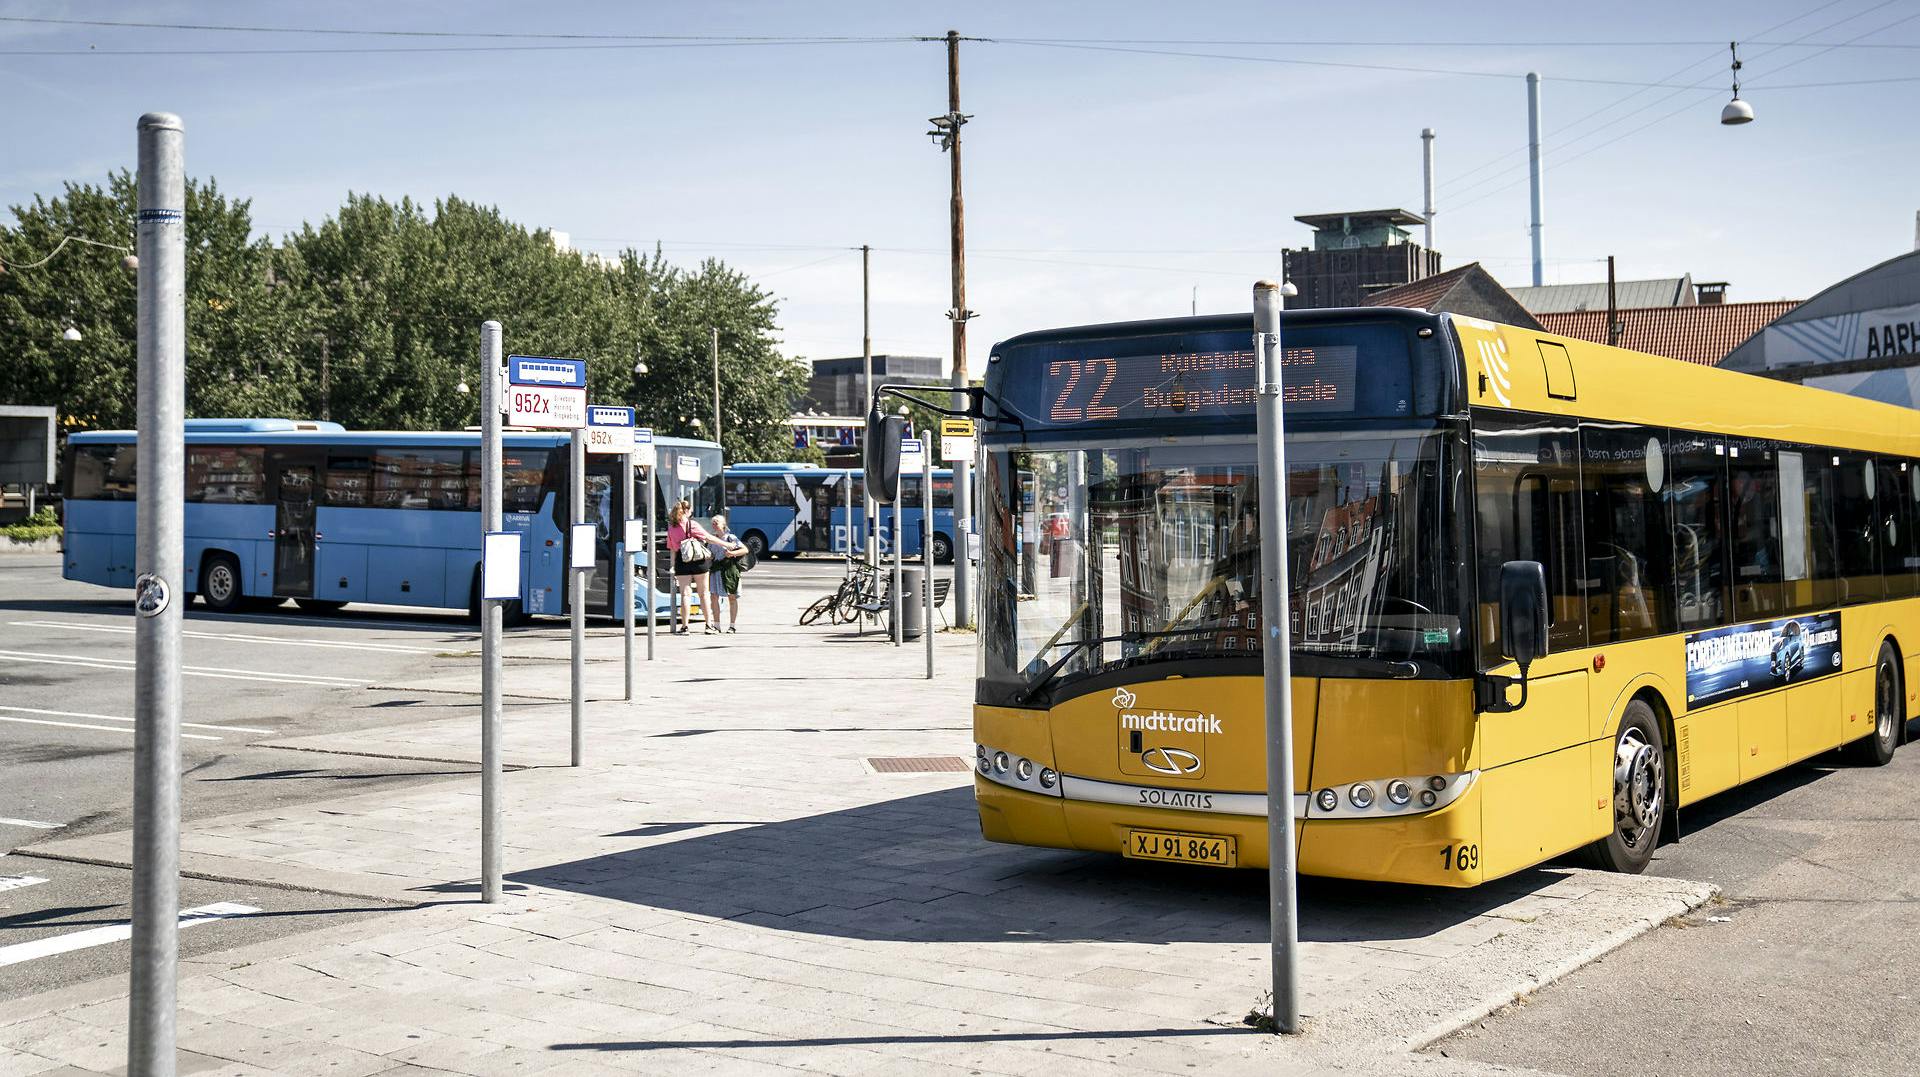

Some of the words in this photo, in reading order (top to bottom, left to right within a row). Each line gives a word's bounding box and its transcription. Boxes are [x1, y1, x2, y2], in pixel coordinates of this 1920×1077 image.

[1161, 350, 1255, 372] Rutebils
[1049, 358, 1119, 421] 22
[1284, 380, 1337, 402] asle
[515, 393, 550, 414] 952x
[591, 431, 613, 445] 952x
[1122, 711, 1222, 734] midttrafik
[1139, 789, 1213, 809] SOLARIS
[1137, 835, 1160, 854] XJ
[1164, 836, 1183, 857] 91
[1188, 839, 1221, 862] 864
[1440, 843, 1479, 872] 169
